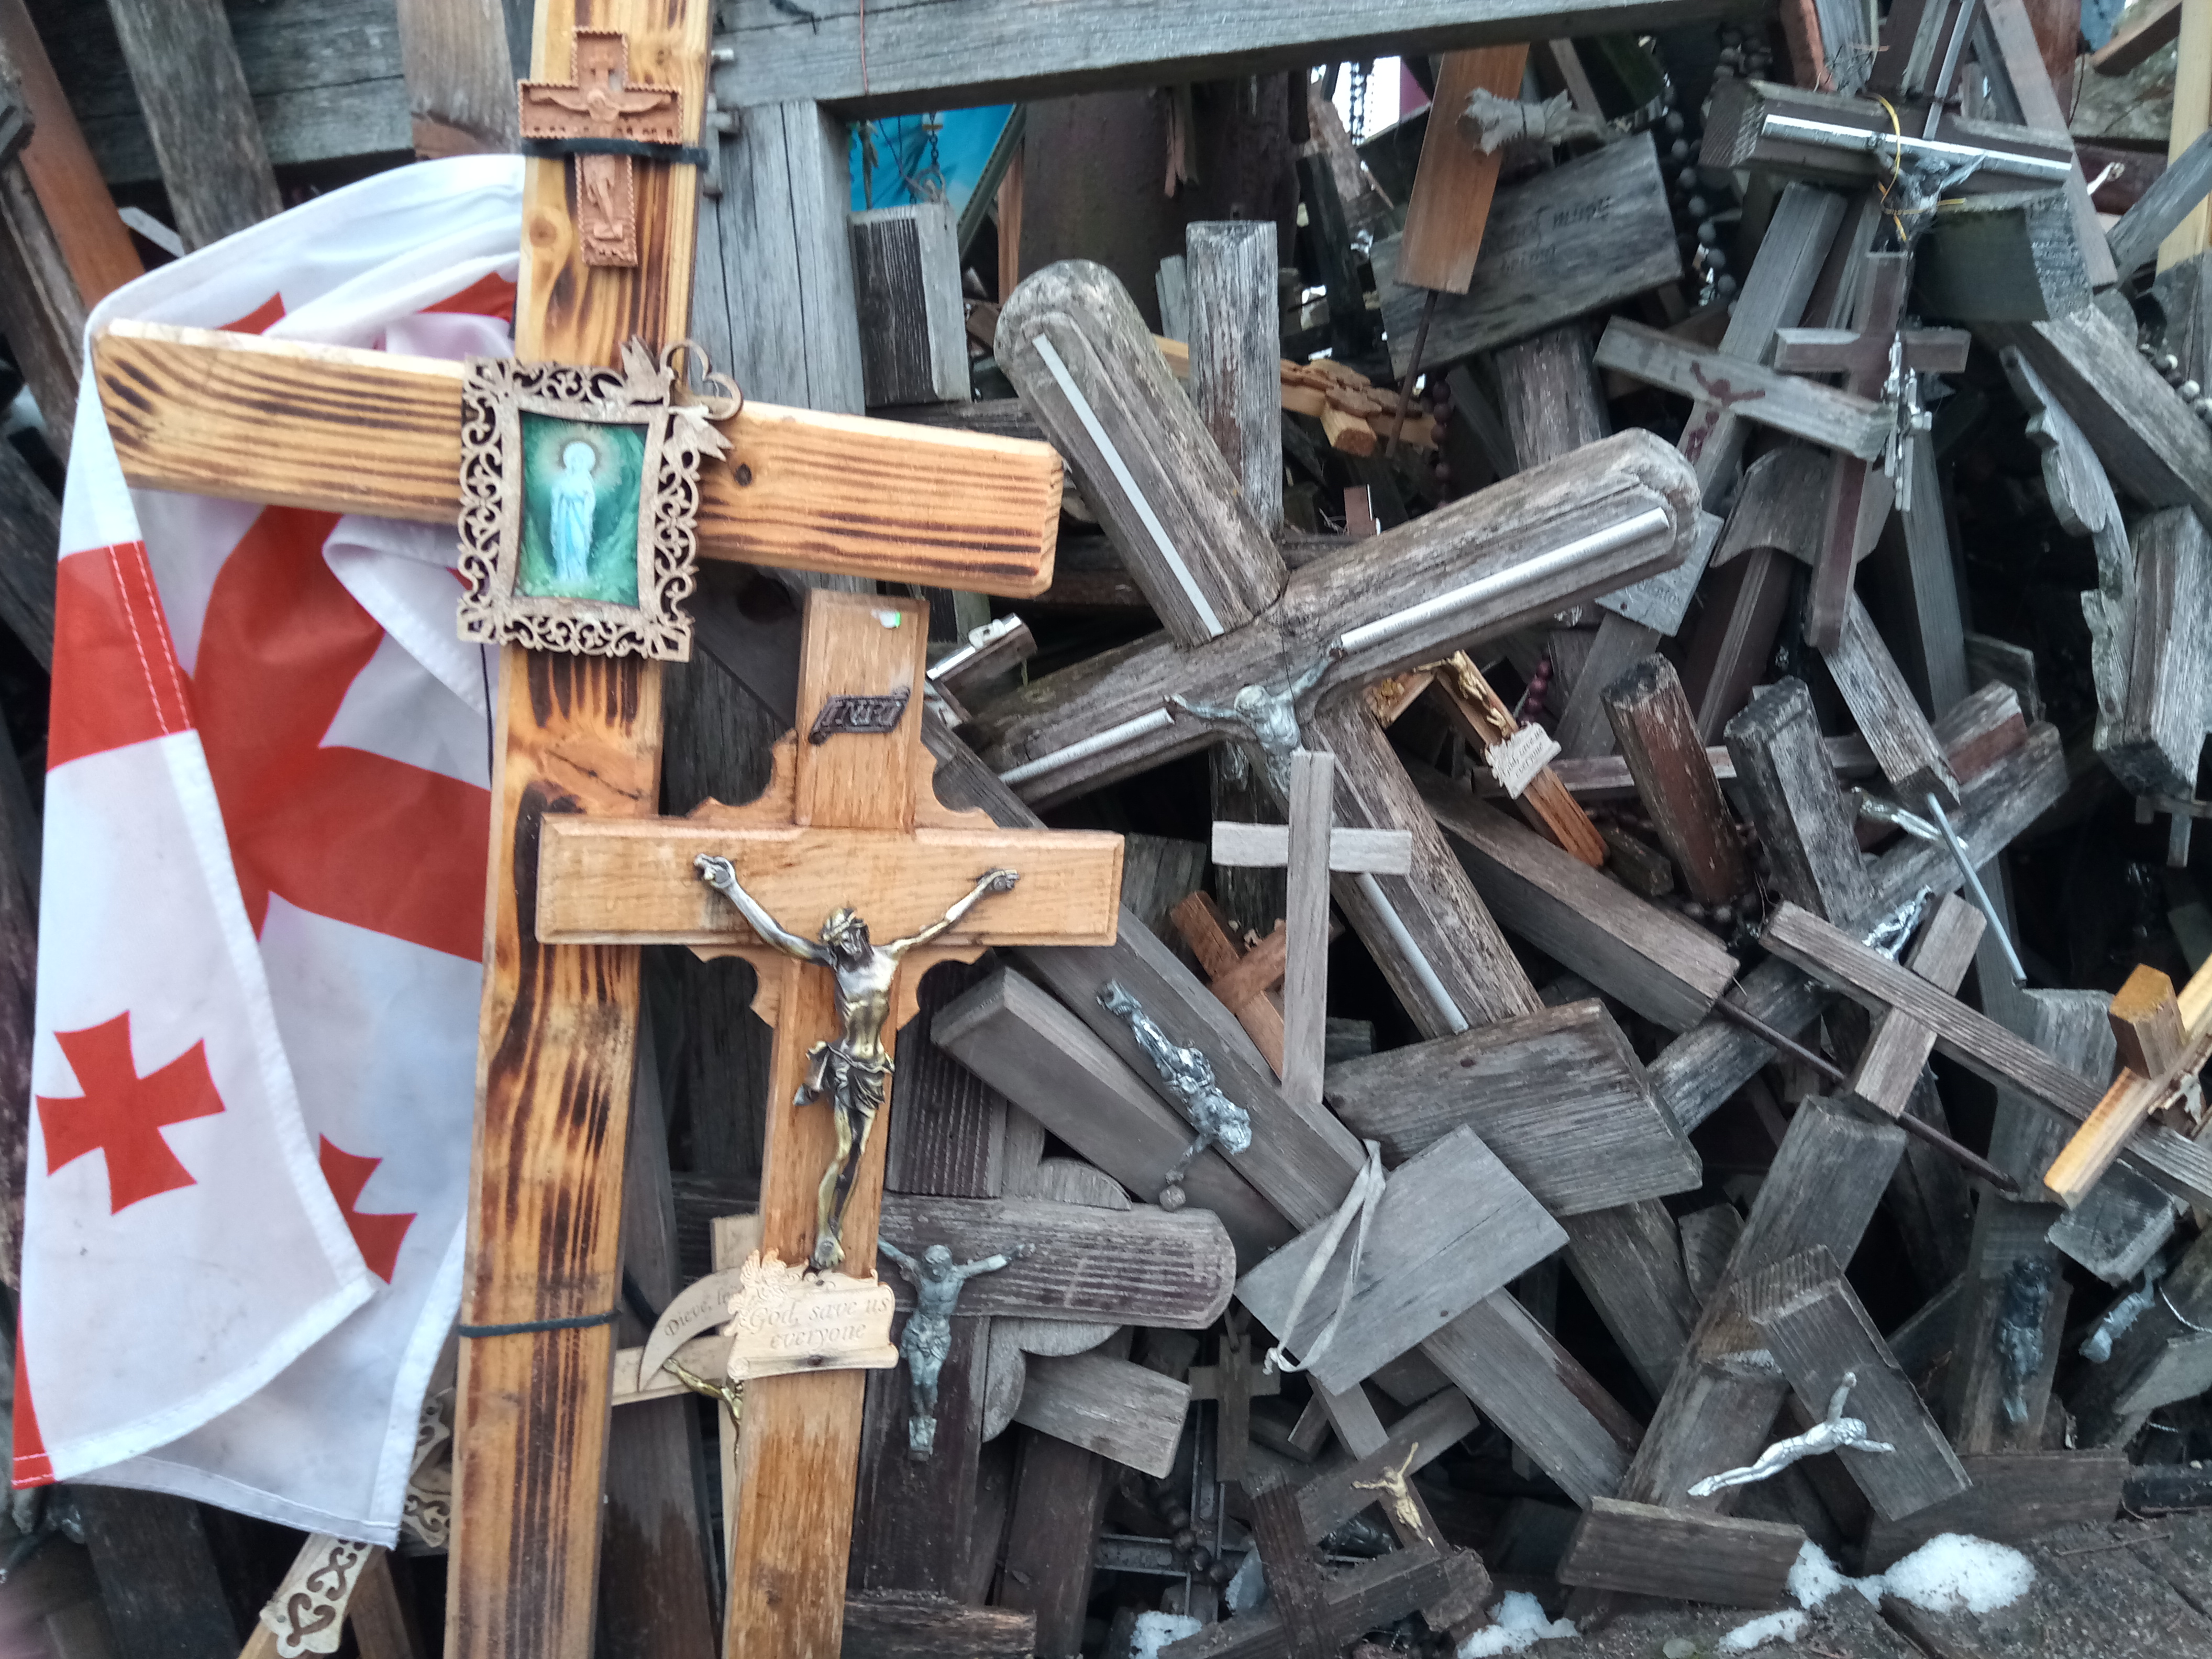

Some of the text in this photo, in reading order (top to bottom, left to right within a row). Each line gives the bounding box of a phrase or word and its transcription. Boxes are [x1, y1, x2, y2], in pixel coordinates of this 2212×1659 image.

[749, 1297, 890, 1333] God, save us
[770, 1323, 867, 1351] everyone
